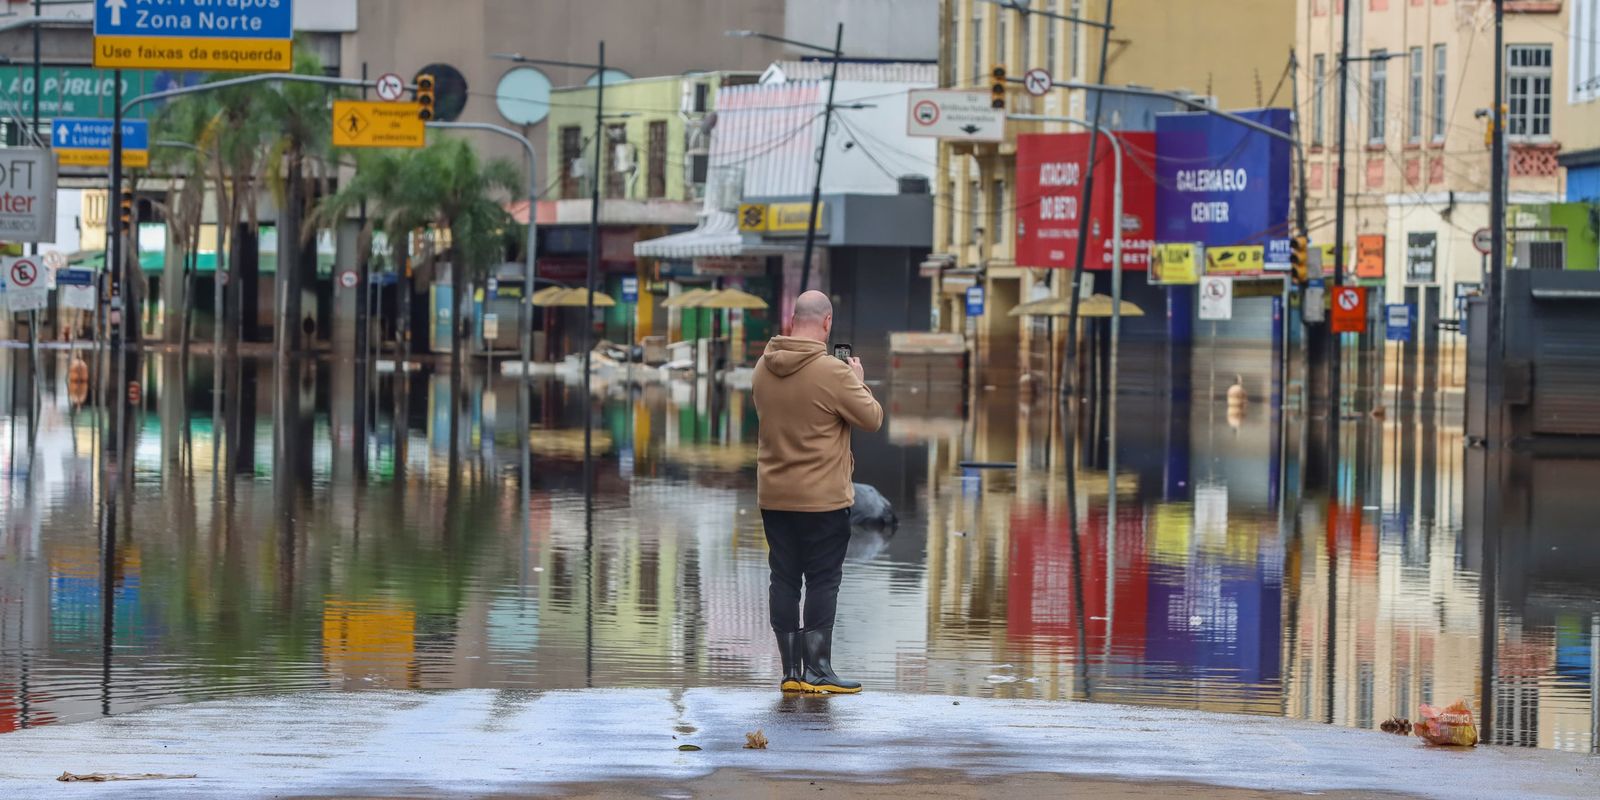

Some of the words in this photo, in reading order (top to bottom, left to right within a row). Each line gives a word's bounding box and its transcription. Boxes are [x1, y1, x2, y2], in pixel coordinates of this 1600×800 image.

[180, 0, 280, 10] apos
[136, 10, 192, 29] Zona
[199, 12, 262, 31] Norte
[102, 45, 132, 58] Use
[137, 46, 183, 60] faixas
[189, 47, 208, 60] da
[212, 48, 283, 62] esquerda
[8, 77, 36, 95] AO
[72, 122, 135, 137] Aeropto
[0, 160, 37, 190] FT
[1039, 162, 1080, 186] ATACADO
[0, 191, 36, 213] ter
[1041, 196, 1053, 219] DO
[1054, 196, 1078, 219] BETO
[1191, 202, 1229, 224] CENTER
[1103, 239, 1155, 250] AACADO
